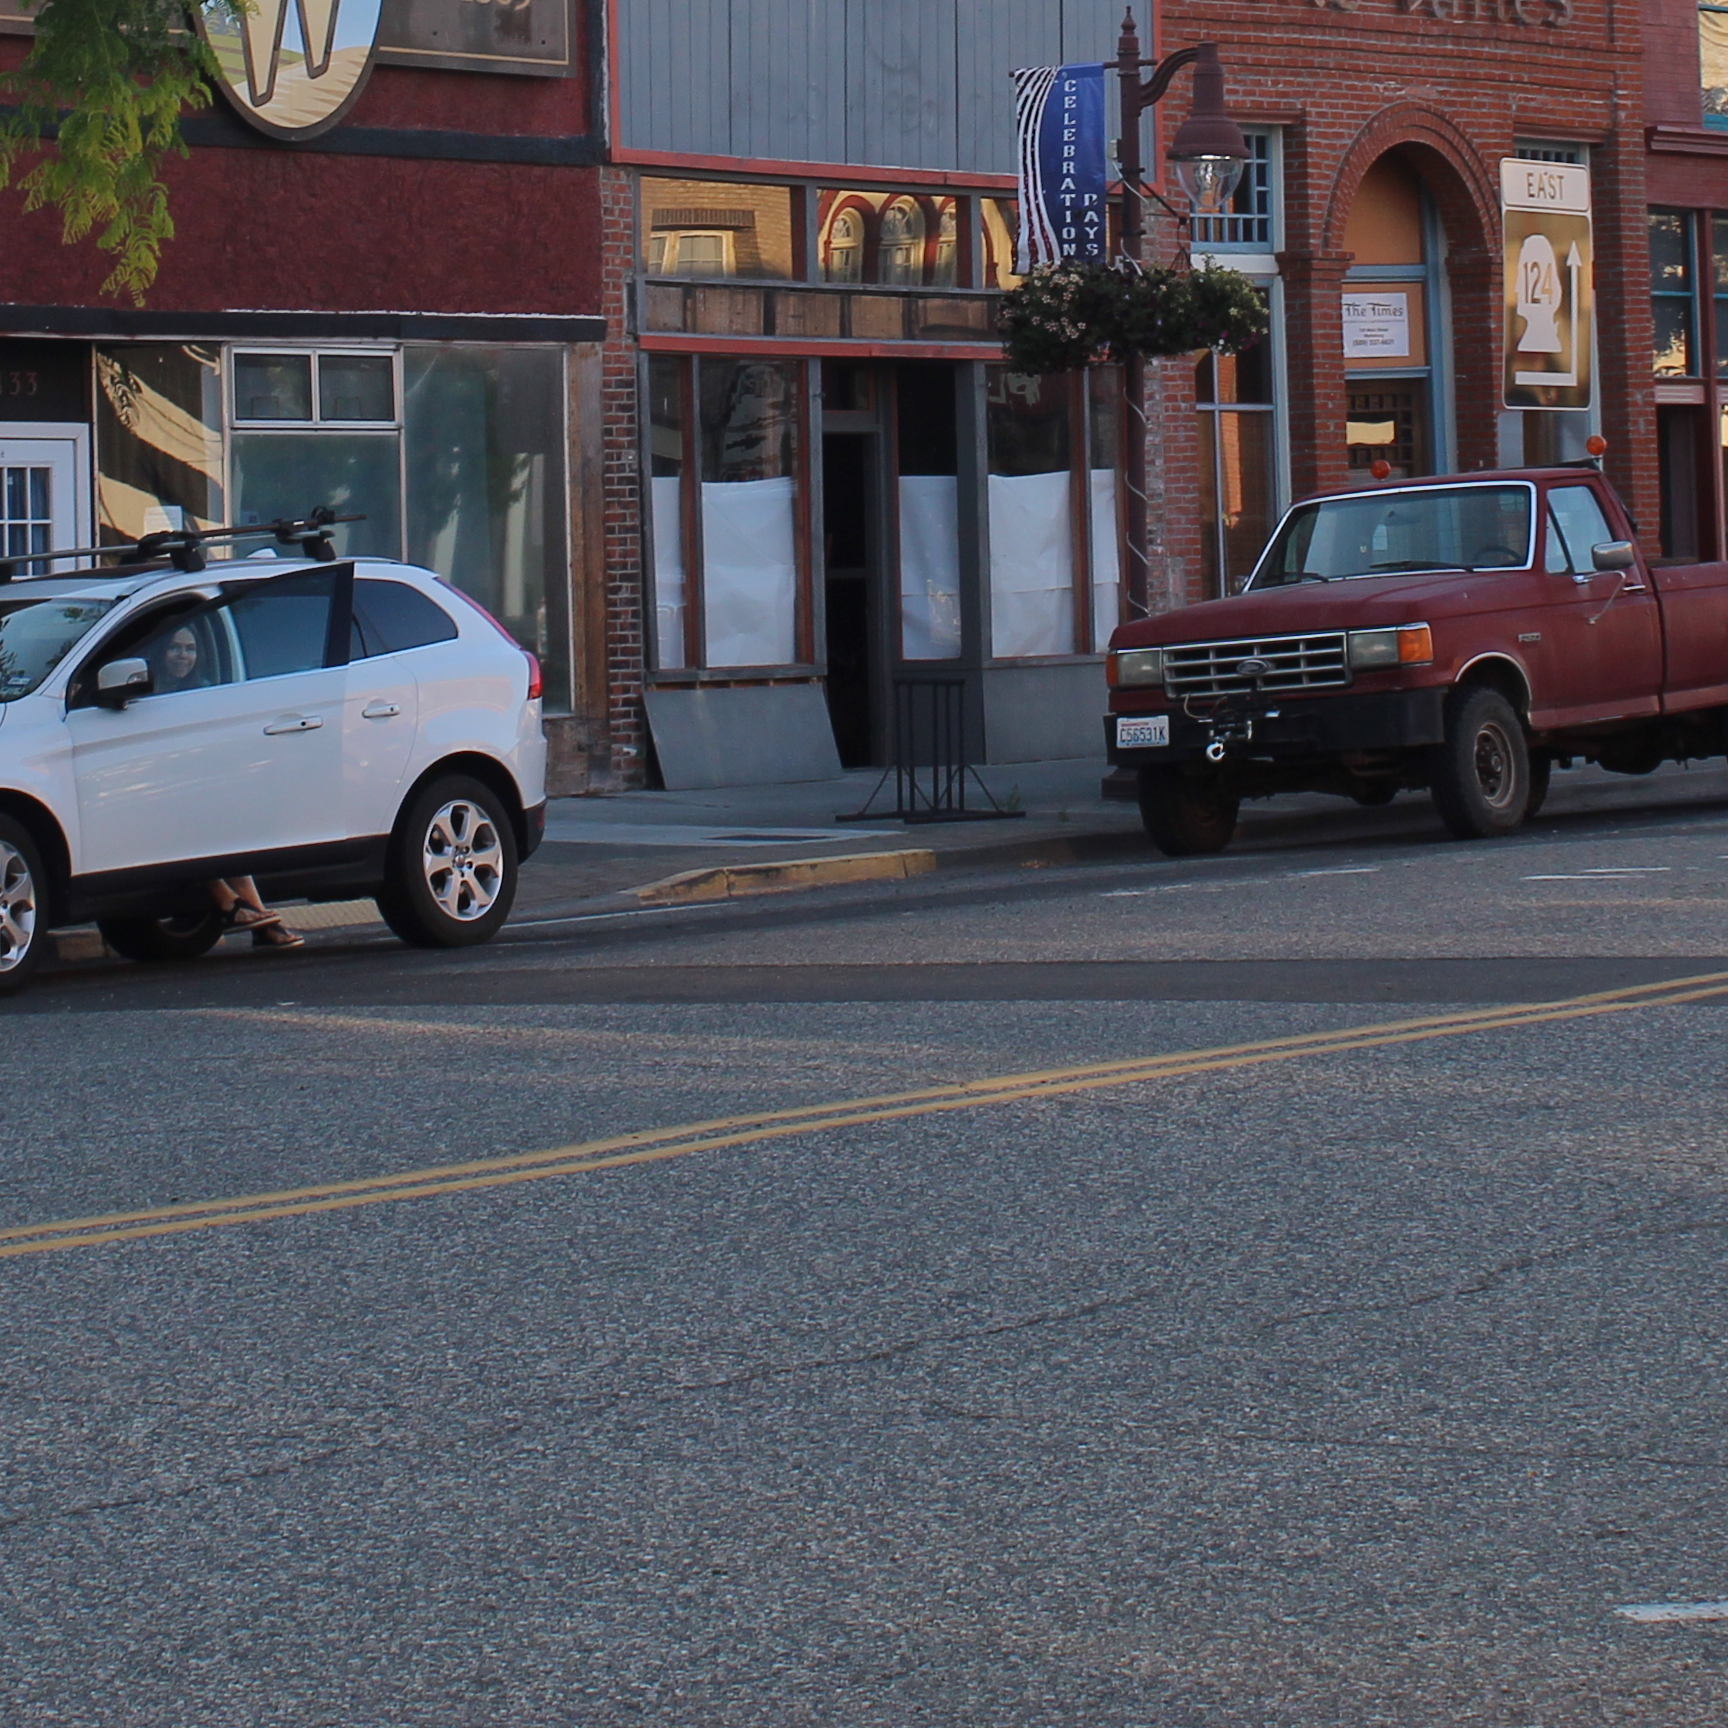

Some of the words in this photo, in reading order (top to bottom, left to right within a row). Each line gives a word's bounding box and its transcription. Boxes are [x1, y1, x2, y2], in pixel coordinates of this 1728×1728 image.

[1060, 79, 1077, 257] CELEBRATION
[1526, 171, 1564, 201] EAST
[1083, 193, 1099, 257] DAYS
[1524, 261, 1554, 304] 124
[1343, 302, 1366, 317] The
[1366, 302, 1403, 317] Times
[1120, 726, 1166, 743] C56531K
